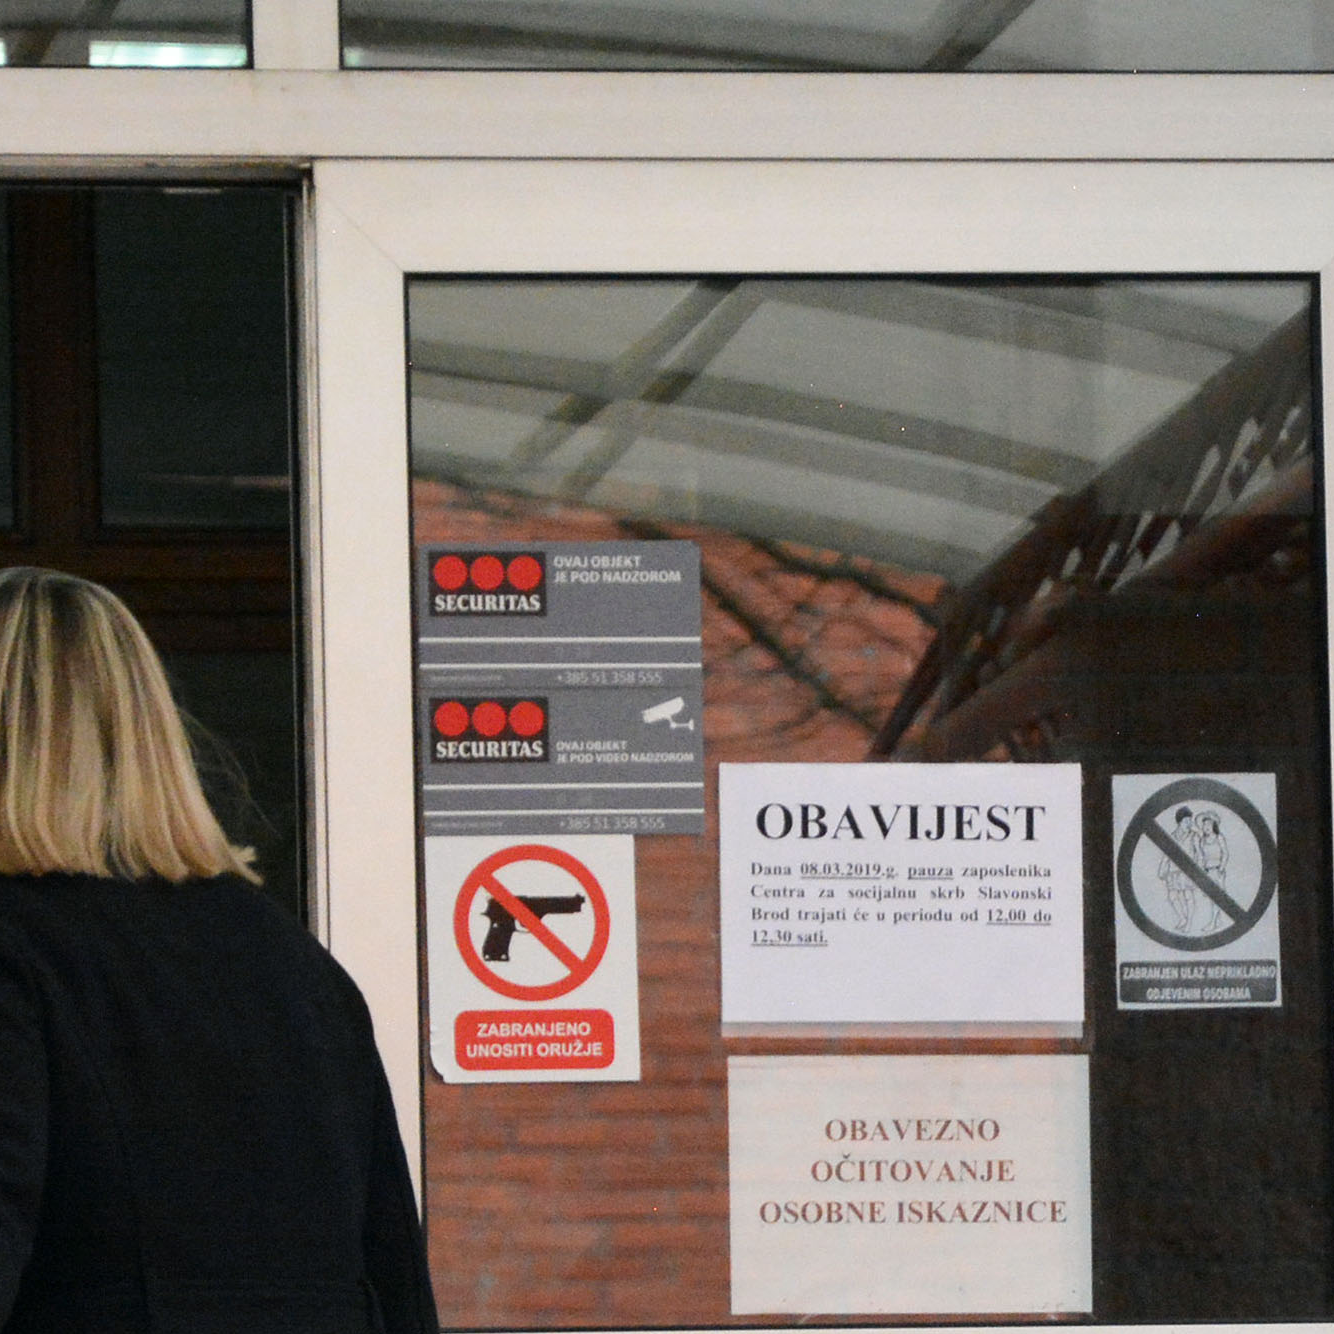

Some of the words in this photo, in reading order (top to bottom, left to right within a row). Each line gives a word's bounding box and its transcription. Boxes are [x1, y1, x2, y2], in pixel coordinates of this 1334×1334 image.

[553, 555, 589, 568] OVAJ
[591, 555, 642, 568] OBJEKT
[553, 570, 568, 583] JE
[570, 570, 601, 583] POD
[603, 570, 681, 583] NADZOROM
[434, 594, 541, 613] SECURITAS
[592, 671, 608, 686] 51
[639, 671, 663, 685] 555
[436, 740, 544, 759] SECURITAS
[556, 740, 586, 751] OVAJ
[588, 740, 627, 751] OBJEKT
[556, 753, 568, 764] JE
[570, 753, 594, 764] POD
[596, 753, 629, 763] VIDEO
[631, 752, 694, 763] NADZOROM
[640, 817, 665, 830] 555
[756, 802, 1046, 841] OBAVIJEST
[750, 862, 792, 877] Dana
[800, 862, 899, 880] 08.03.2019.g.
[907, 865, 954, 880] pauza
[961, 864, 1052, 880] zaposlenika
[750, 884, 805, 899] Centra
[818, 887, 835, 899] za
[848, 885, 916, 902] socijalnu
[930, 885, 965, 900] skrb
[978, 885, 1052, 900] Slavonski
[751, 907, 789, 921] Brod
[798, 907, 846, 924] trajati
[853, 908, 870, 921] će
[877, 912, 886, 921] u
[893, 908, 953, 924] periodu
[960, 908, 979, 922] od
[1033, 908, 1052, 922] do
[797, 929, 828, 944] sati.
[1122, 966, 1179, 980] ZABRANJEN
[1180, 966, 1206, 979] ULAZ
[1203, 987, 1252, 1001] OSOBAMA
[477, 1022, 591, 1038] ZABRANJENO
[467, 1043, 534, 1058] UNOSITI
[537, 1040, 603, 1057] ORUŽJE
[825, 1118, 1001, 1142] OBAVEZNO
[811, 1152, 1016, 1183] OČITOVANJE
[759, 1201, 886, 1224] OSOBNE
[897, 1200, 1067, 1224] ISKAZNICE
